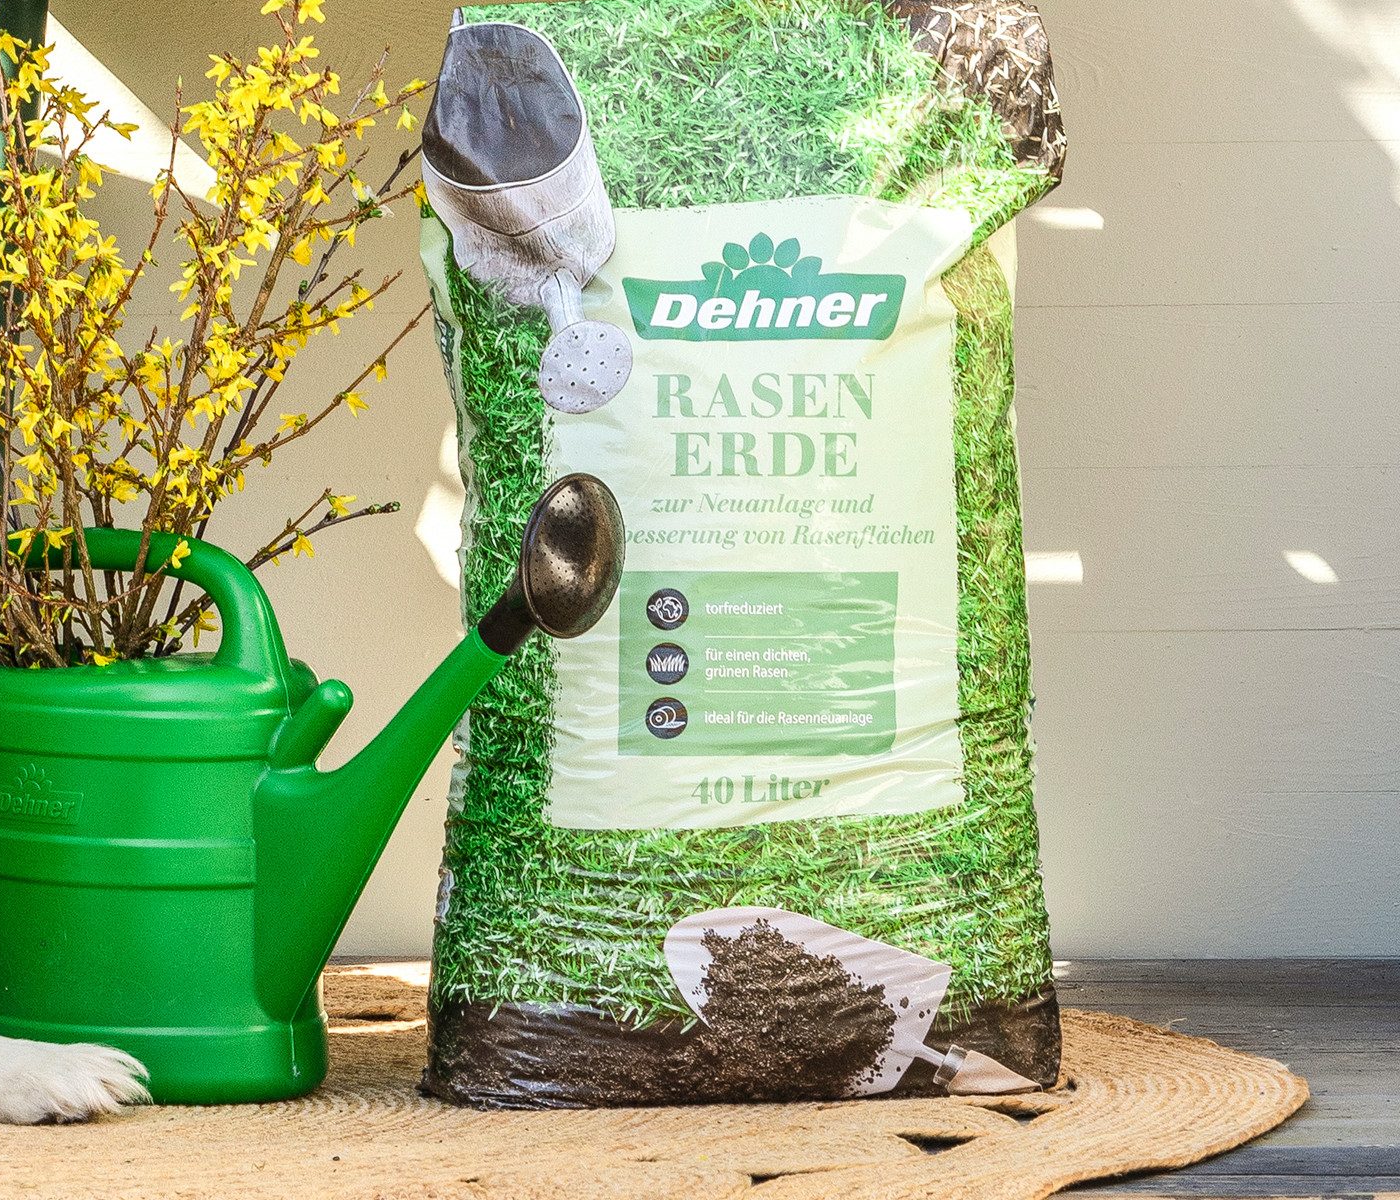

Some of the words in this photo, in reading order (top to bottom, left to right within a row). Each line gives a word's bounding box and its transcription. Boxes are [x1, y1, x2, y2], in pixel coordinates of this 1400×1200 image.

[650, 290, 888, 329] Dehner
[651, 372, 876, 420] RASEN
[670, 431, 858, 478] ERDE
[650, 497, 694, 514] zur
[697, 492, 826, 519] Neuanlage
[830, 493, 875, 514] und
[744, 530, 786, 545] von
[792, 524, 936, 550] Rasenflächen
[705, 602, 784, 616] torfreduziert
[705, 648, 722, 661] für
[726, 648, 759, 662] einen
[763, 647, 811, 663] dichten,
[705, 665, 749, 681] grünen
[753, 665, 789, 678] Rasen
[705, 710, 734, 725] ideal
[737, 710, 754, 725] für
[757, 710, 775, 725] die
[778, 710, 873, 726] Rasenneuanlage
[691, 775, 734, 805] 40
[741, 773, 830, 804] Liter
[0, 792, 75, 818] Dehner
